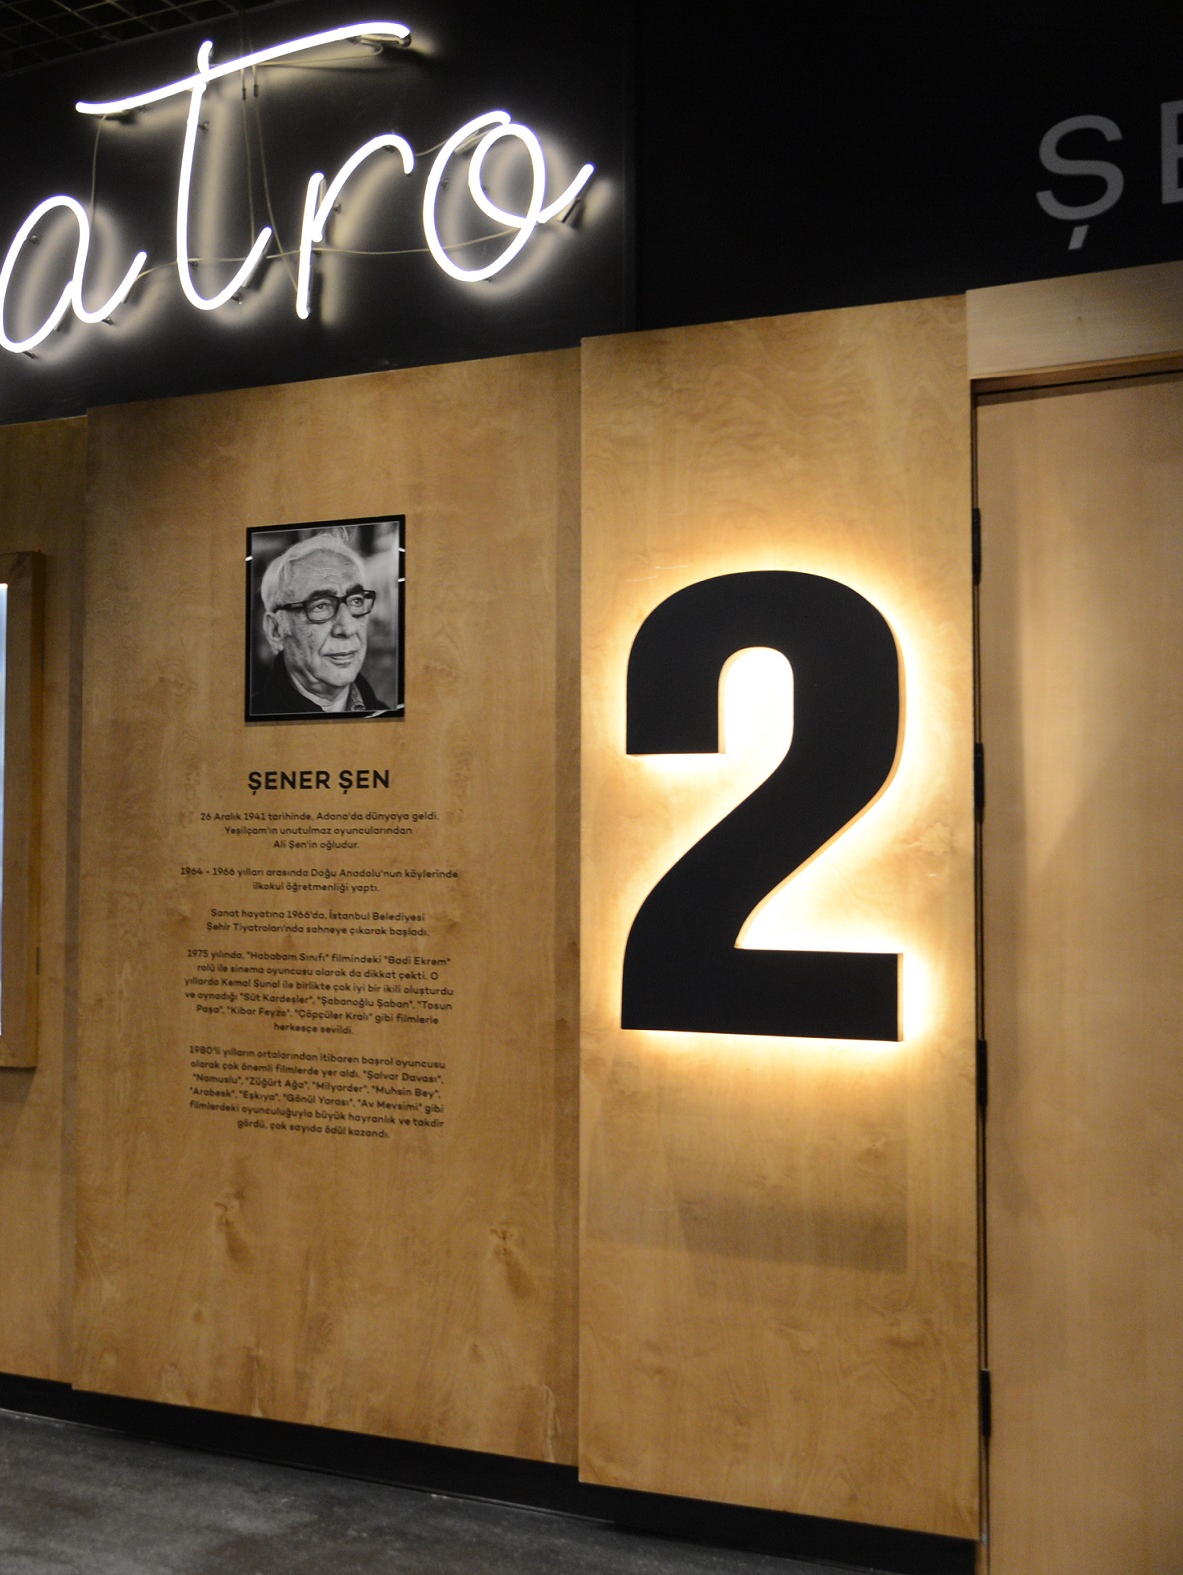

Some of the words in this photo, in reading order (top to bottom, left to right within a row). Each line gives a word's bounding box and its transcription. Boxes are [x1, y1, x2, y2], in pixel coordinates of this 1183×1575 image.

[248, 770, 331, 796] ŞENER
[338, 769, 390, 795] ŞEN
[621, 569, 907, 1043] 2
[200, 812, 212, 821] 26
[213, 812, 242, 821] Aralık
[244, 812, 266, 821] 1941
[365, 812, 410, 823] dünyaya
[280, 826, 332, 835] unutulmaz
[333, 826, 413, 837] oyuncularından
[273, 840, 287, 849] Ali
[180, 867, 203, 876] 1964
[212, 867, 235, 876] 1966
[237, 867, 264, 878] yılları
[266, 867, 309, 877] arasında
[311, 868, 337, 879] Doğu
[404, 869, 460, 880] köylerinde
[285, 882, 349, 894] öğretmenliği
[211, 909, 240, 919] Sanat
[241, 910, 285, 921] hayatına
[329, 911, 370, 921] İstanbul
[372, 912, 425, 924] Belediyesi
[206, 922, 231, 934] Şehir
[306, 925, 347, 937] sahneye
[349, 926, 387, 938] çıkarak
[187, 950, 209, 960] 1975
[331, 954, 382, 964] filmindeki
[197, 964, 216, 973] rolü
[217, 964, 228, 974] ile
[230, 965, 265, 975] sinema
[266, 968, 313, 978] oyuncusu
[315, 968, 347, 978] olarak
[349, 969, 362, 978] da
[364, 969, 396, 979] dikkat
[430, 971, 439, 981] O
[221, 979, 251, 989] Kemal
[253, 980, 281, 990] Sunal
[282, 981, 294, 990] ile
[295, 981, 331, 992] birlikte
[333, 983, 351, 994] çok
[353, 983, 365, 995] iyi
[367, 984, 381, 994] bir
[383, 985, 401, 994] ikili
[403, 985, 454, 998] oluşturdu
[197, 991, 238, 1004] oynadığı
[375, 1013, 394, 1025] gibi
[396, 1014, 439, 1025] filmlerle
[273, 1023, 318, 1036] herkesçe
[222, 1048, 256, 1060] yılların
[256, 1050, 318, 1062] ortalarından
[320, 1053, 360, 1065] itibaren
[361, 1056, 394, 1068] başrol
[395, 1060, 446, 1072] oyuncusu
[190, 1060, 220, 1071] olarak
[222, 1062, 239, 1074] çok
[241, 1063, 273, 1074] önemli
[275, 1065, 319, 1077] filmlerde
[321, 1070, 337, 1080] yer
[189, 1101, 240, 1113] filmlerdeki
[241, 1104, 313, 1120] oyunculuğuyla
[315, 1110, 346, 1123] büyük
[348, 1112, 396, 1126] hayranlık
[398, 1118, 411, 1126] ve
[412, 1117, 445, 1128] takdir
[424, 1103, 444, 1115] gibi
[269, 1122, 287, 1134] çok
[289, 1123, 322, 1137] sayıda
[324, 1126, 346, 1137] ödül
